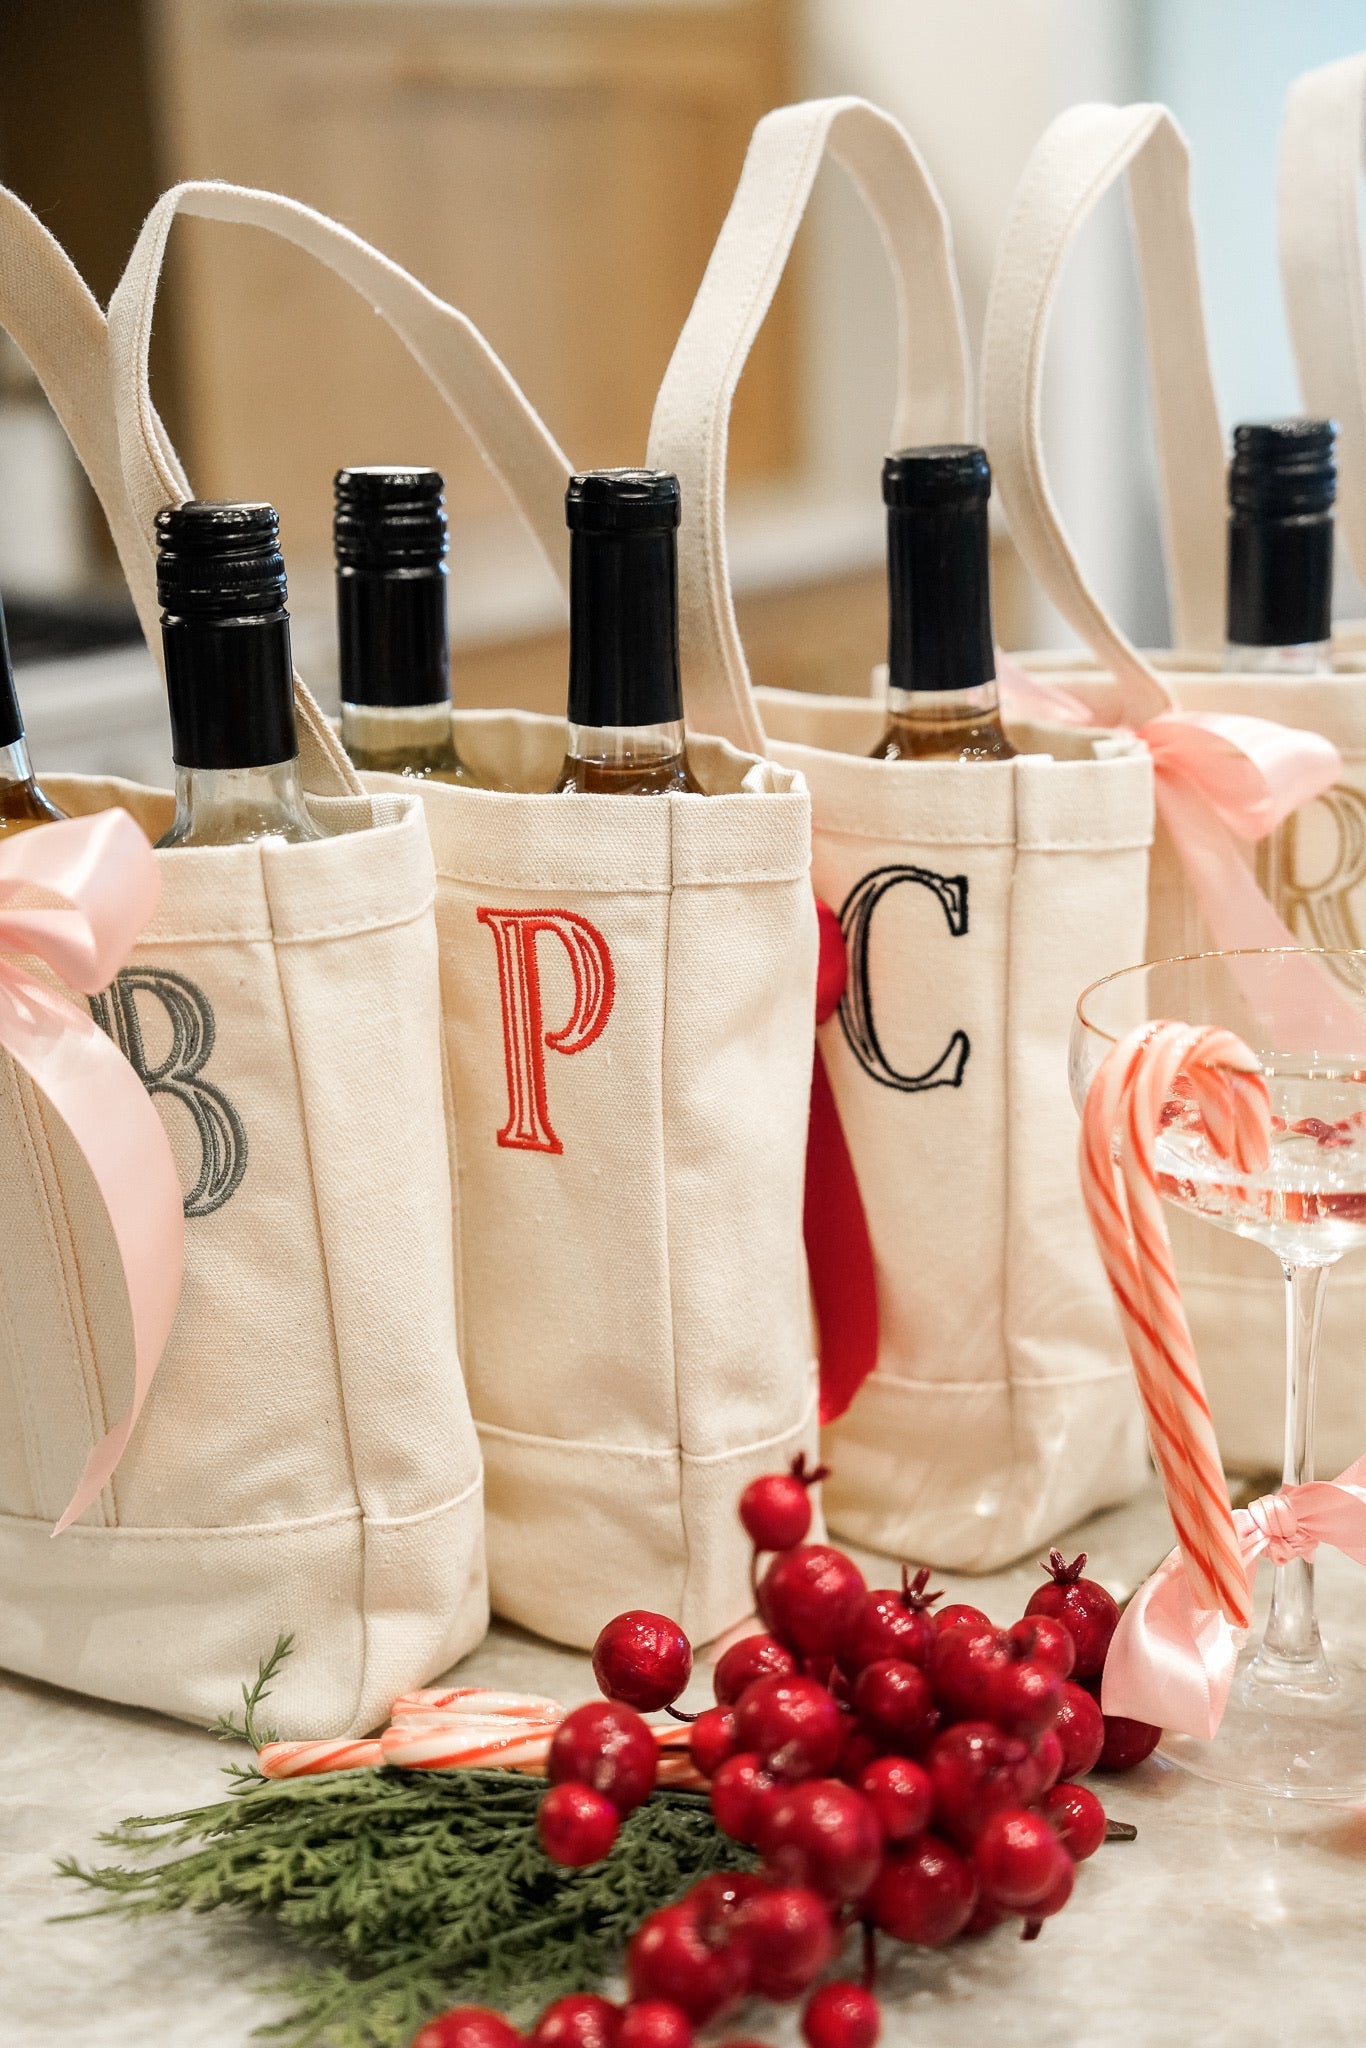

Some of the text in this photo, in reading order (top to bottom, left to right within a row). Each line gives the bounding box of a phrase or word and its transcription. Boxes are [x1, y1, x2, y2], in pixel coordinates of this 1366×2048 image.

[87, 965, 248, 1218] B
[477, 906, 616, 1155] P
[838, 865, 970, 1092] C
